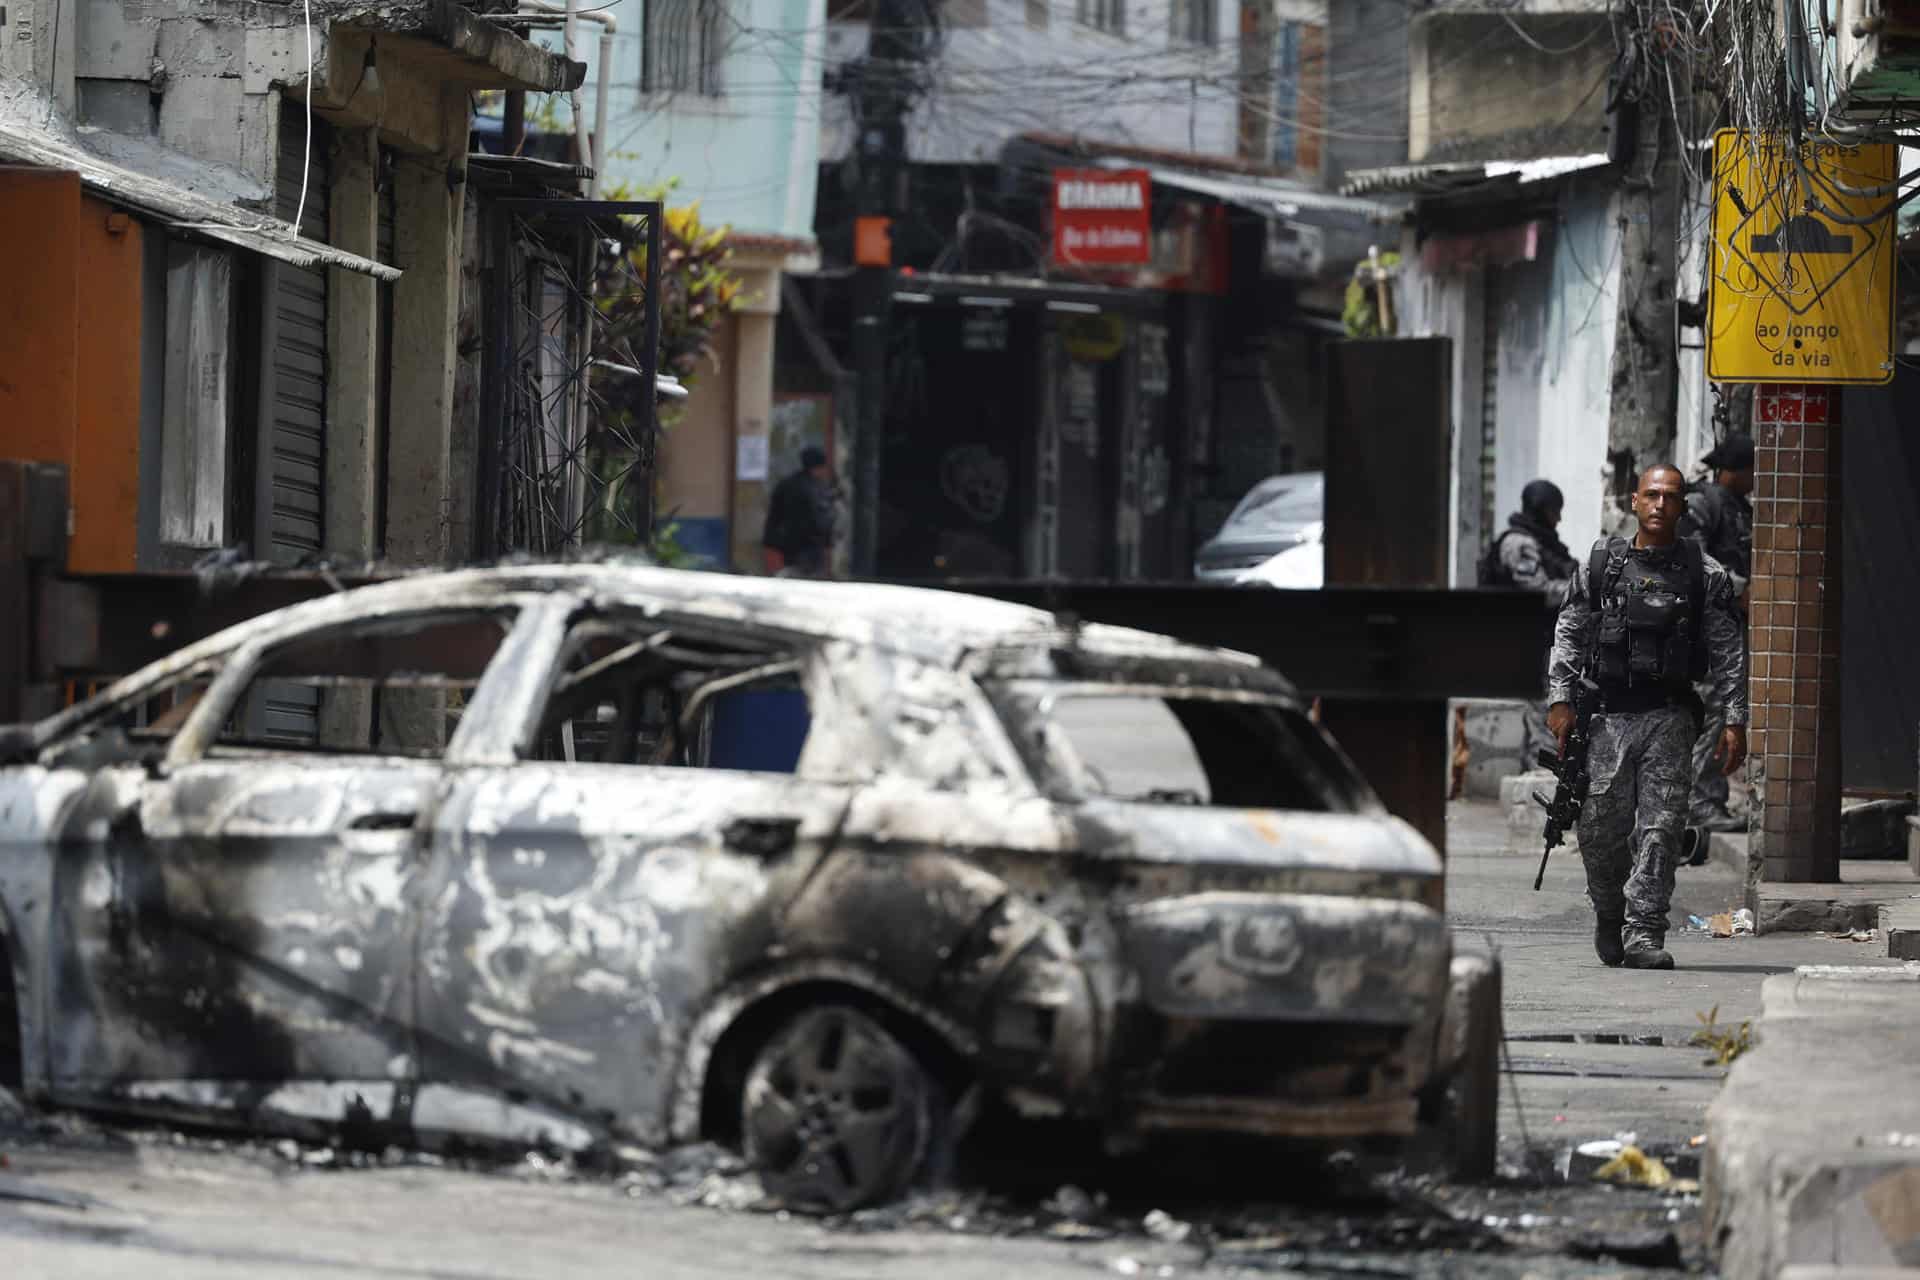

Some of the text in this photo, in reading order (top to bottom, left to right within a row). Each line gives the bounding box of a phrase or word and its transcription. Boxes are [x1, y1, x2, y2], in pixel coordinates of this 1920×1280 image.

[1758, 323, 1839, 342] ao longo
[1772, 350, 1831, 367] da via
